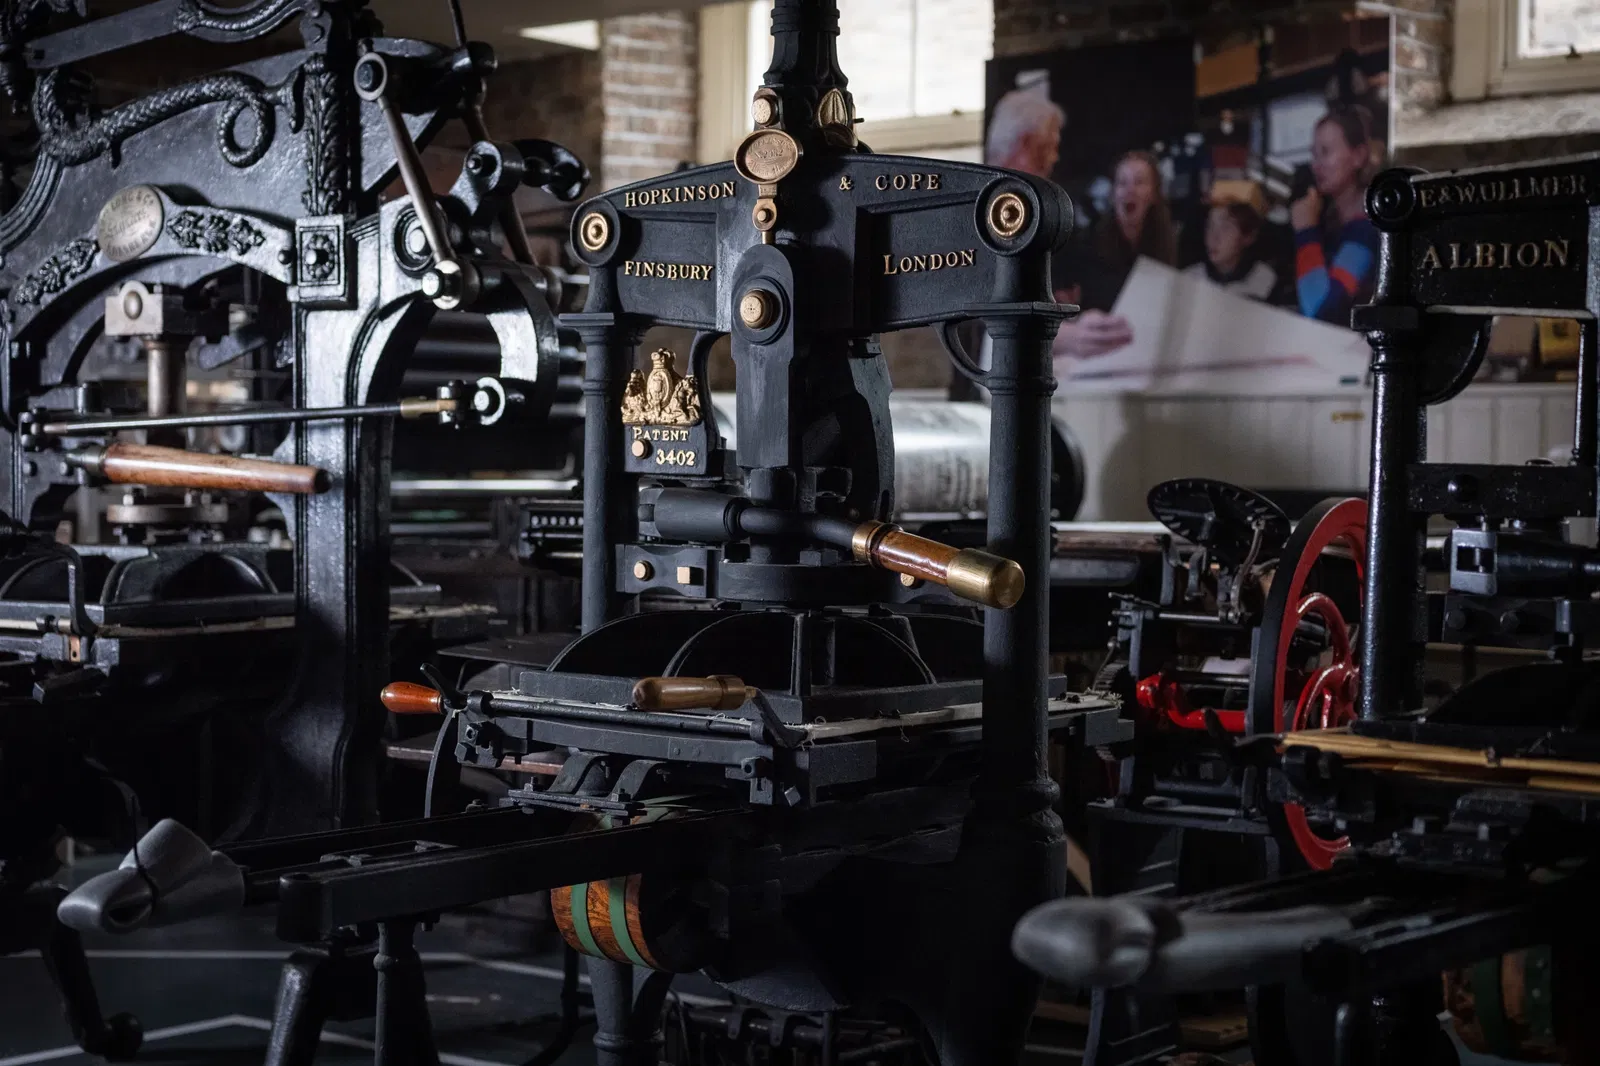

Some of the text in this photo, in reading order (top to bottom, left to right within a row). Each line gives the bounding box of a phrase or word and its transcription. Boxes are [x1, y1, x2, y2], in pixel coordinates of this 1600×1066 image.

[624, 173, 940, 208] HOPKINSON & COPE
[882, 248, 976, 276] LONDON
[1416, 238, 1571, 271] ALBION
[624, 260, 714, 281] FINSBURY
[632, 425, 690, 442] PATENT
[656, 449, 696, 467] 3402
